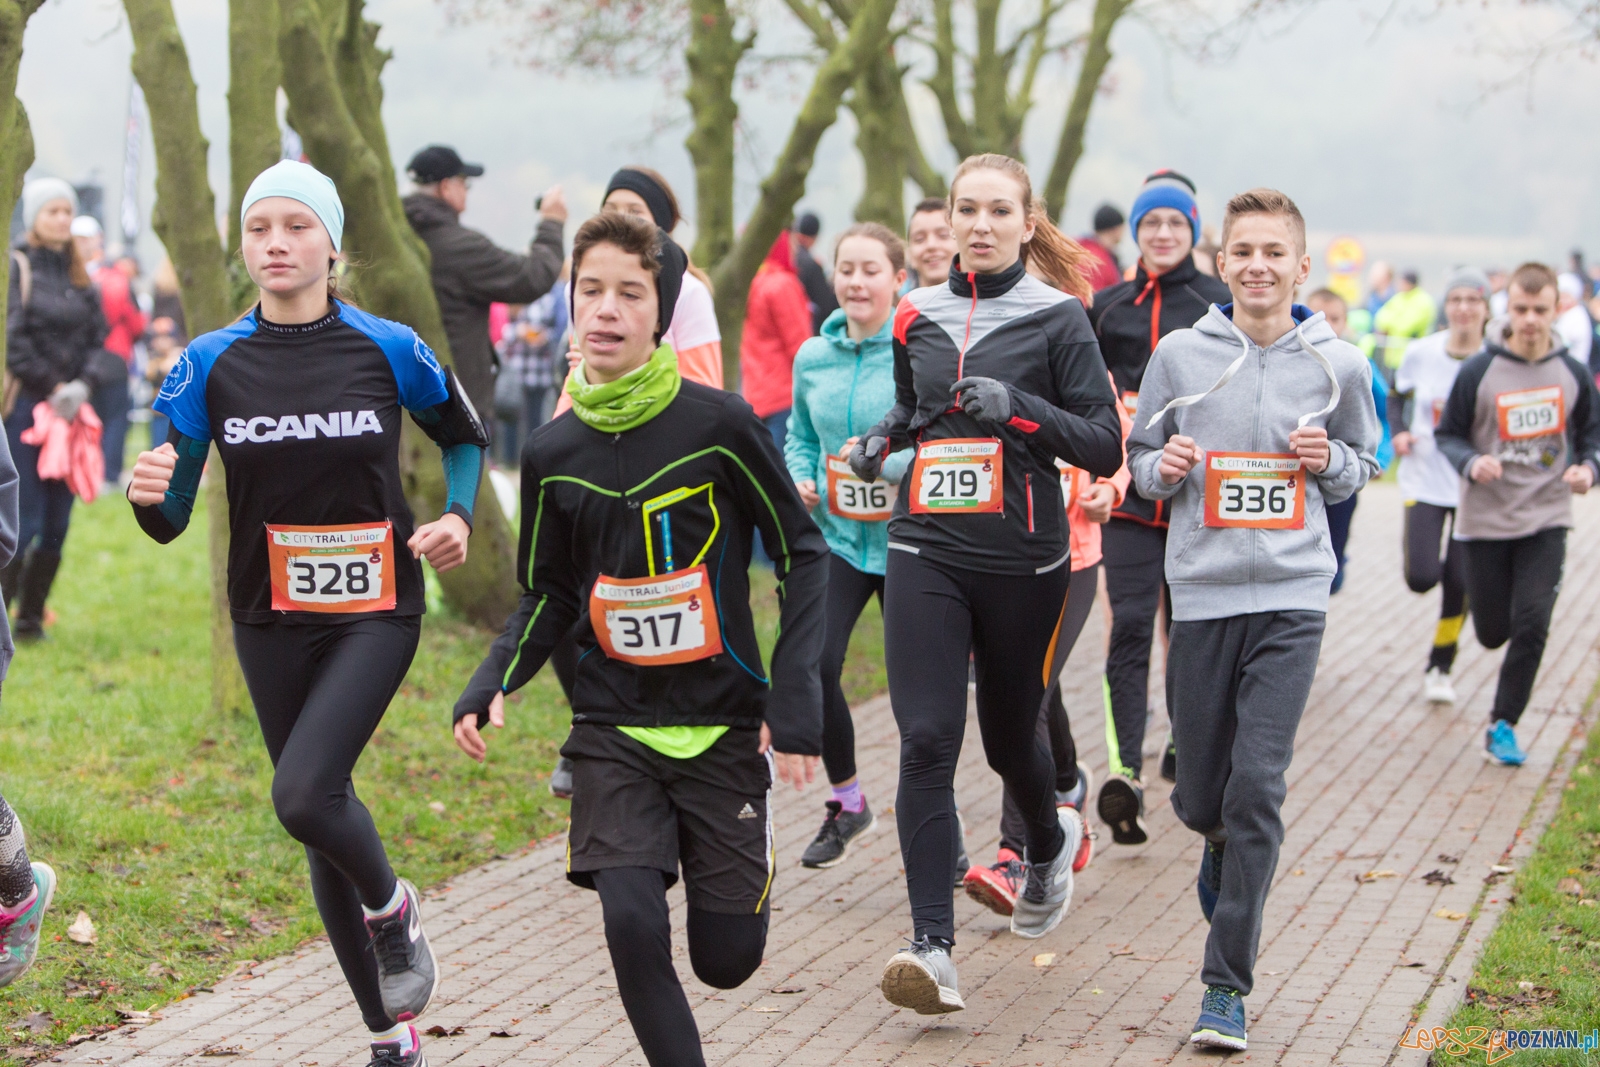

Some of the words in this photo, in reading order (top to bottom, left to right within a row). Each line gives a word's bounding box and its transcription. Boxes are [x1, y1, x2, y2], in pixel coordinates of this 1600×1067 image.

[301, 315, 335, 332] NADZIEI
[223, 410, 384, 444] SCANIA
[1509, 406, 1552, 429] 309
[1274, 460, 1297, 469] Junior
[928, 469, 978, 497] 219
[843, 484, 887, 508] 316
[1225, 484, 1286, 513] 336
[349, 532, 380, 542] Junior
[293, 561, 370, 595] 328
[664, 579, 695, 593] Junior
[618, 611, 682, 648] 317
